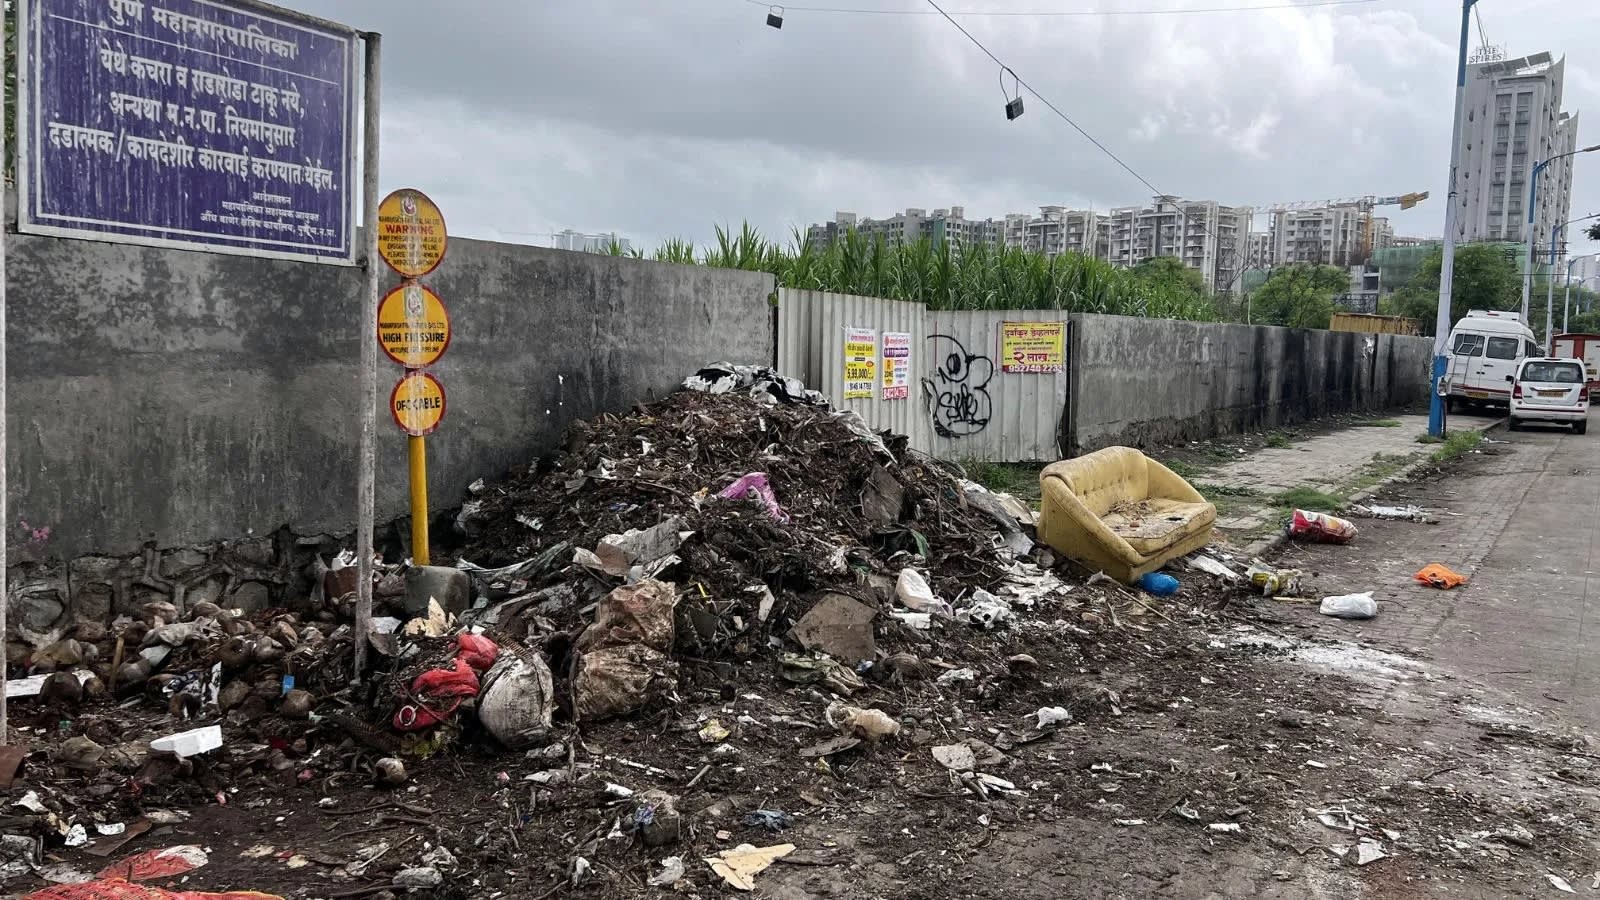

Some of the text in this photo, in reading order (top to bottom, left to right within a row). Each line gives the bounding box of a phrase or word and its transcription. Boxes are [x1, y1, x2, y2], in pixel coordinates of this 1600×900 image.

[152, 6, 298, 60] महानगरपालिका
[1478, 46, 1497, 55] THE
[1469, 53, 1502, 63] SPIRES
[100, 38, 128, 77] येथे
[130, 55, 172, 87] कचरा
[175, 65, 188, 89] व
[250, 82, 279, 118] टाकू
[109, 91, 162, 122] अन्यथा
[224, 105, 296, 154] नियमानुसार
[199, 146, 250, 182] कारवाई
[251, 157, 302, 185] करण्यात
[383, 332, 445, 343] HIGH PSSURE
